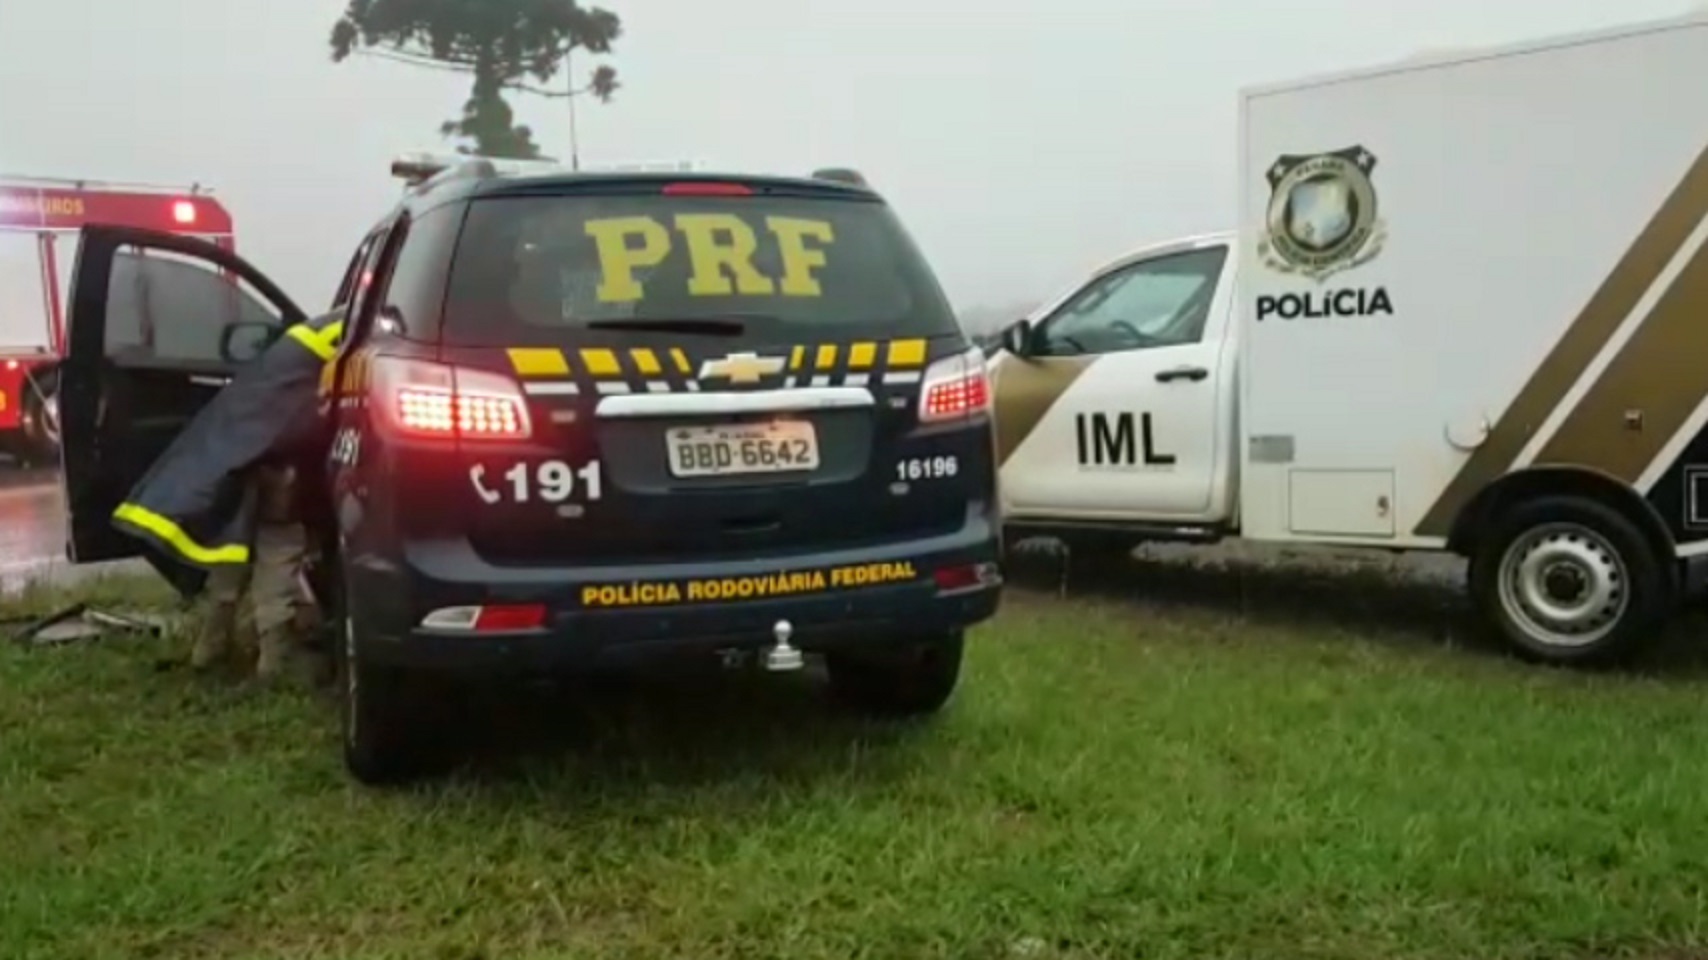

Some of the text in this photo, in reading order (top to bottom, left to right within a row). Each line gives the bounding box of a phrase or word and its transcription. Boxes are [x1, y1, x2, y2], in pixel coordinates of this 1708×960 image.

[584, 213, 835, 302] PRF
[1076, 411, 1176, 465] IML
[505, 460, 602, 502] 191
[896, 455, 958, 480] 16196
[582, 560, 917, 605] POLÍCIA RODOVIÁRIA FEDERAL
